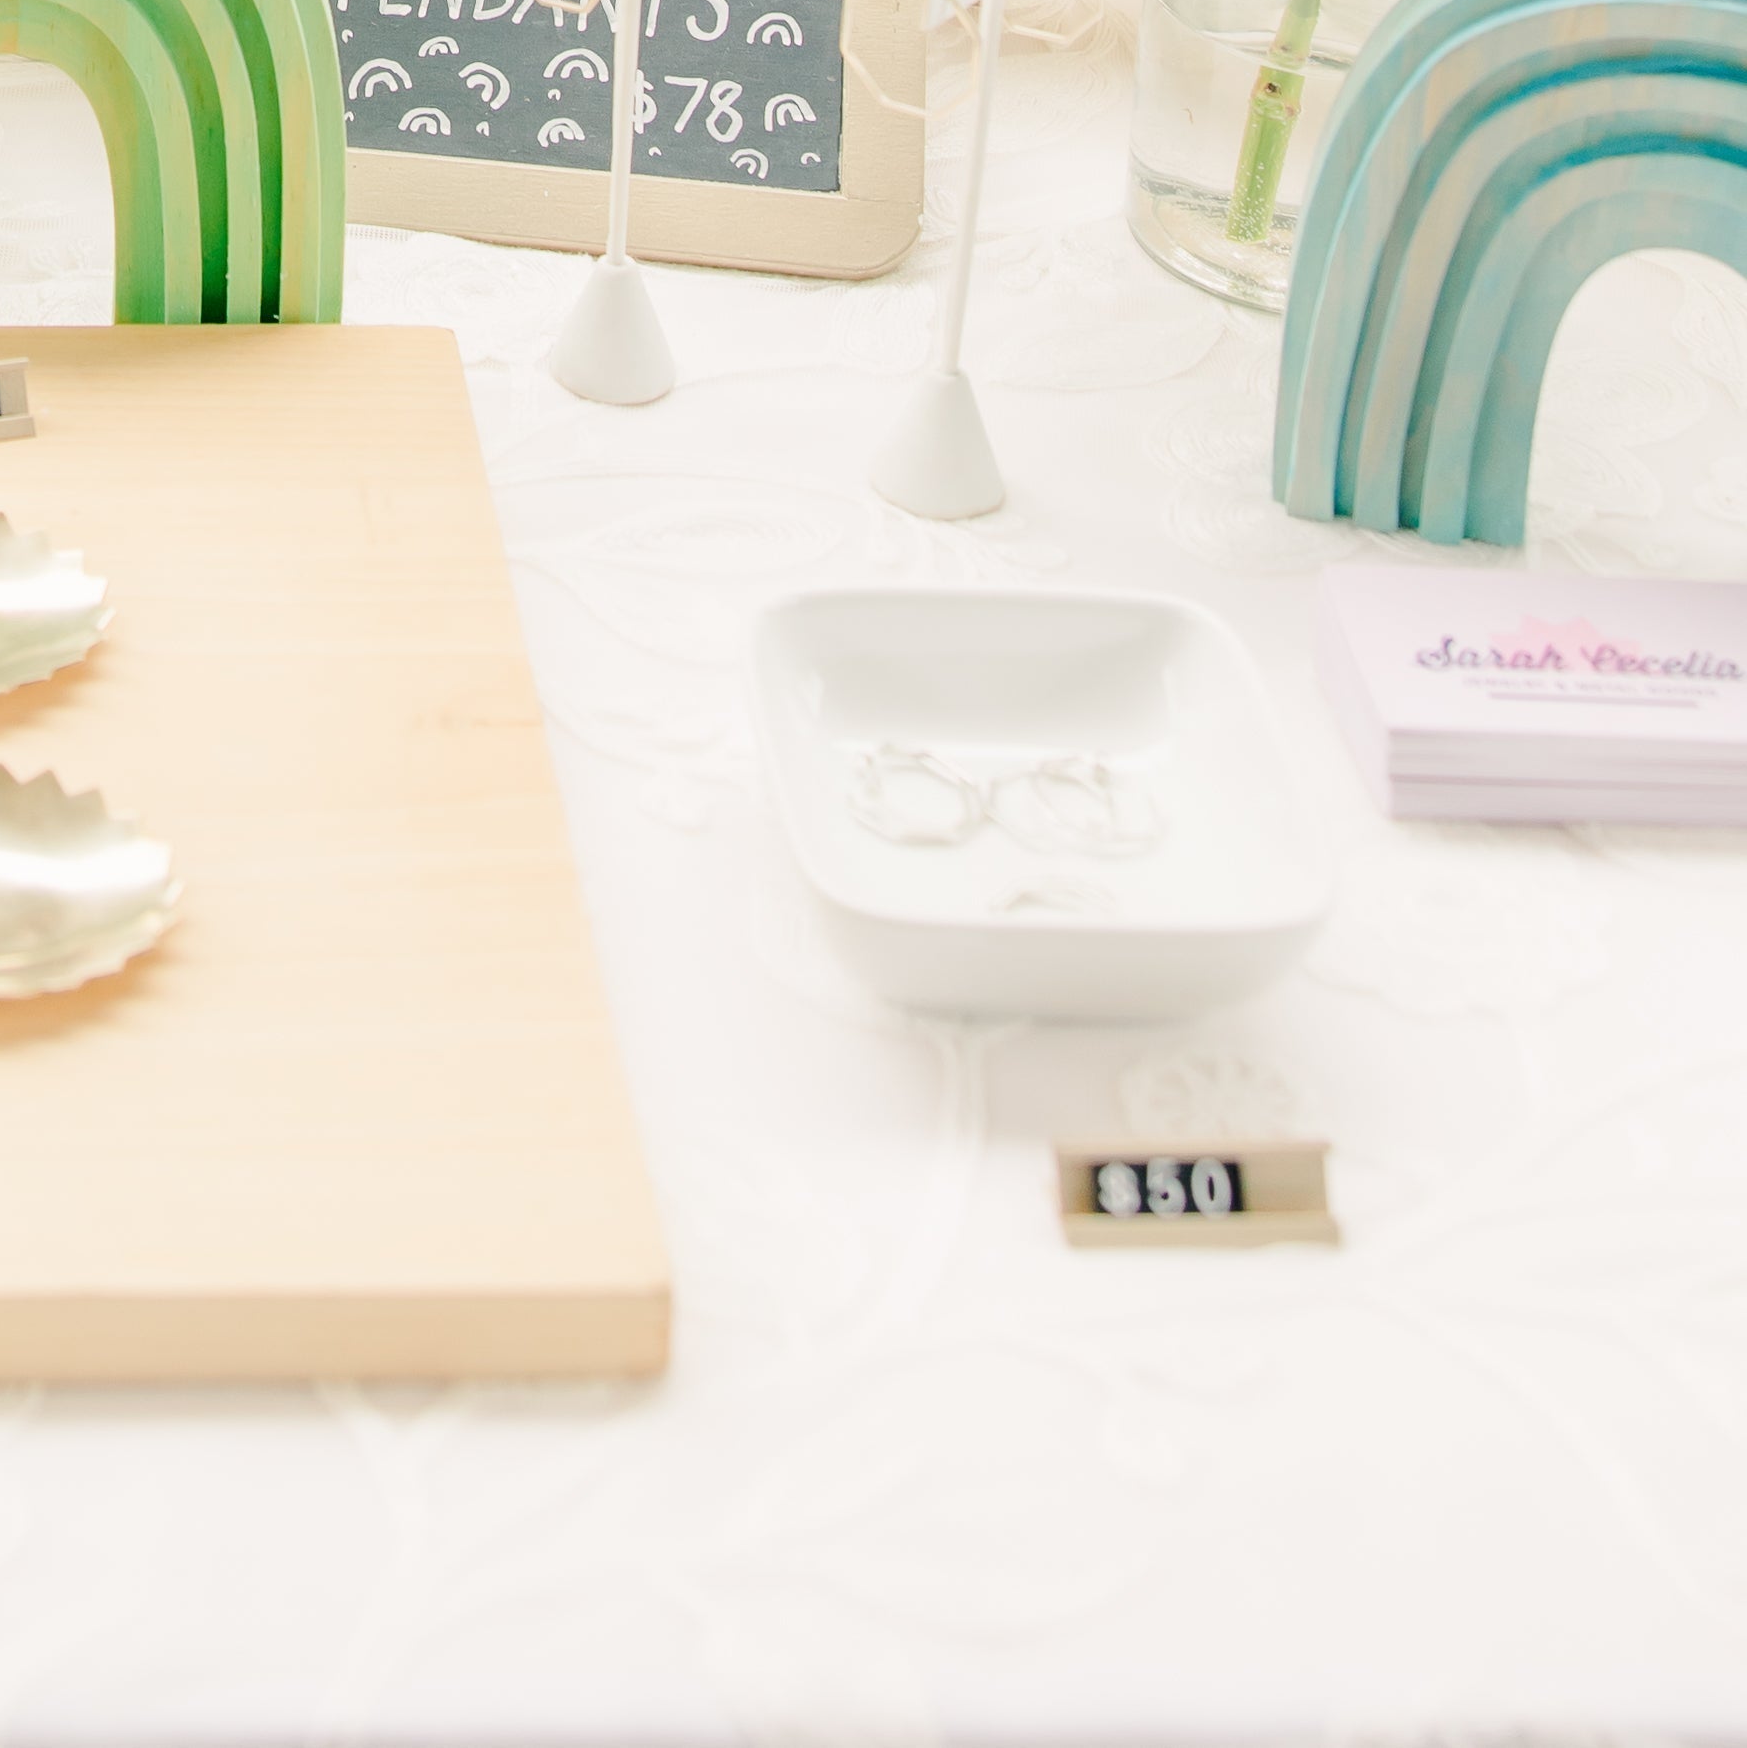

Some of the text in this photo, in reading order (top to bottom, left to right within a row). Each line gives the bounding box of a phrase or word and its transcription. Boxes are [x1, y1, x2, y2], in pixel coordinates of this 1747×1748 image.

[1415, 636, 1742, 681] Sarah Cecelia
[1097, 1156, 1233, 1219] $50
